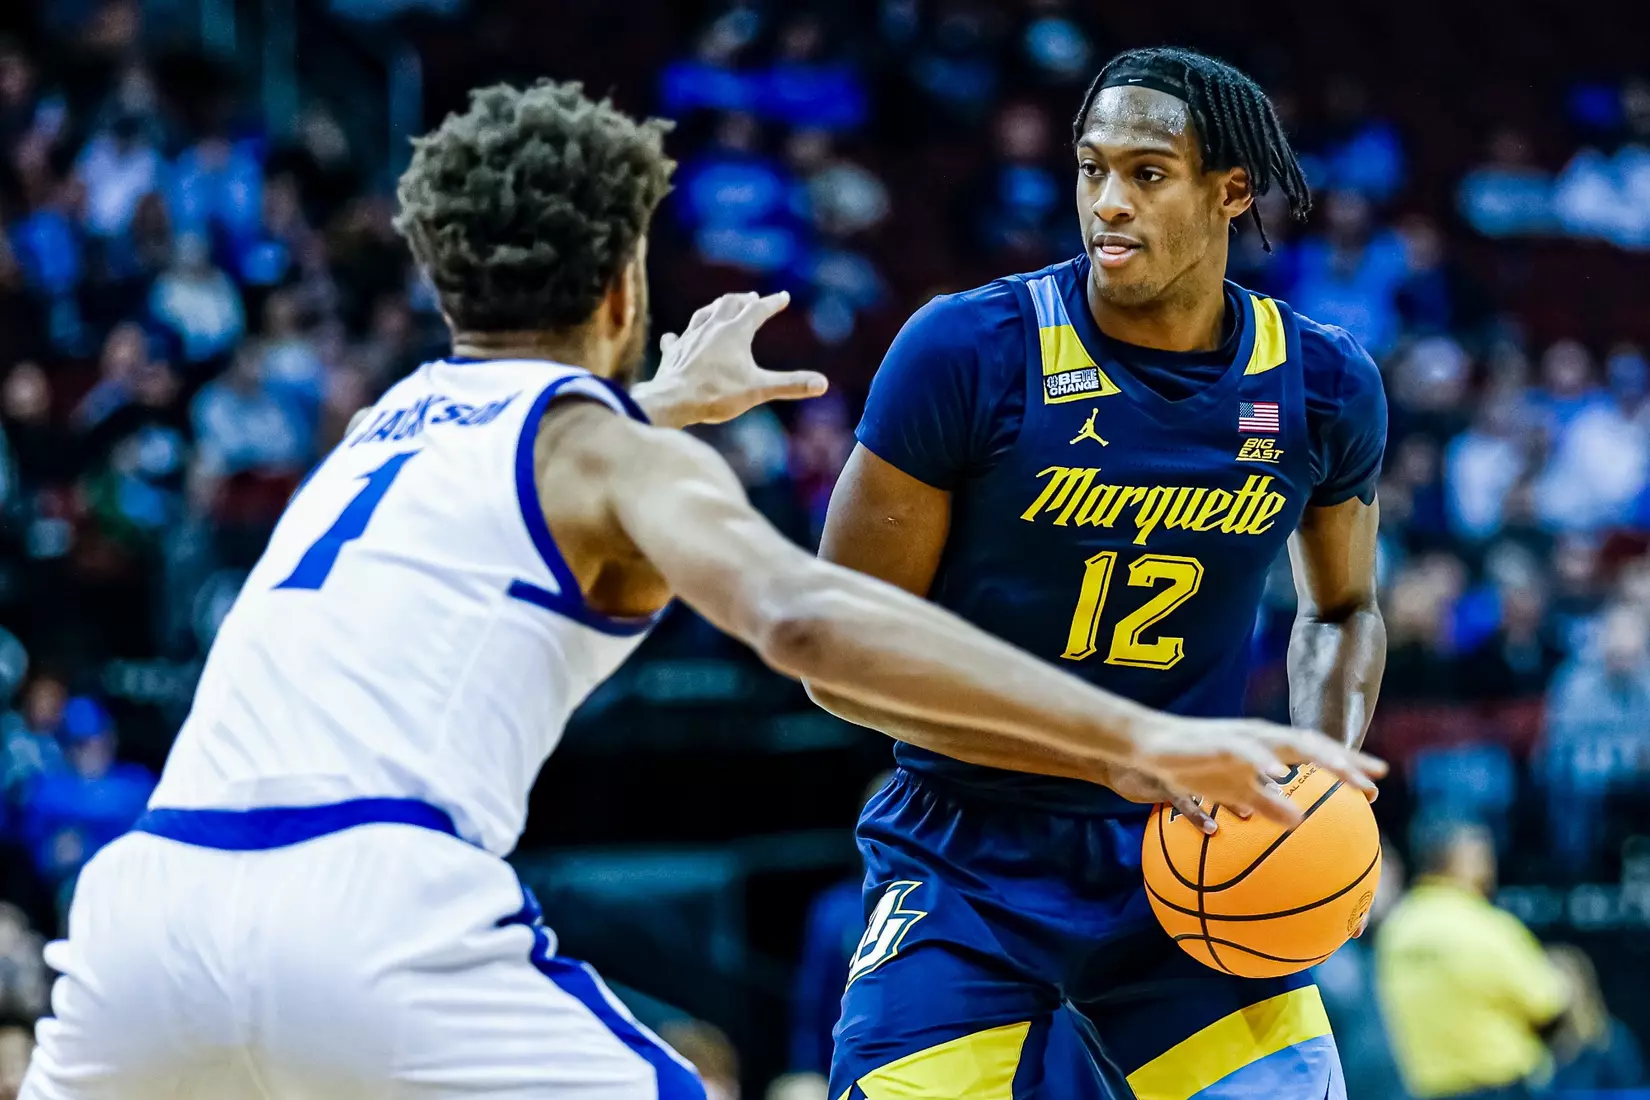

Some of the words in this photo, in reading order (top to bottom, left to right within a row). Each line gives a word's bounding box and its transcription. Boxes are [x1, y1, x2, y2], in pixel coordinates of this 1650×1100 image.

[1049, 380, 1099, 396] CHANGE
[1238, 447, 1284, 460] EAST
[1243, 438, 1276, 449] BIG
[269, 447, 425, 590] 1
[1020, 466, 1286, 545] Marquette
[1060, 551, 1204, 670] 12
